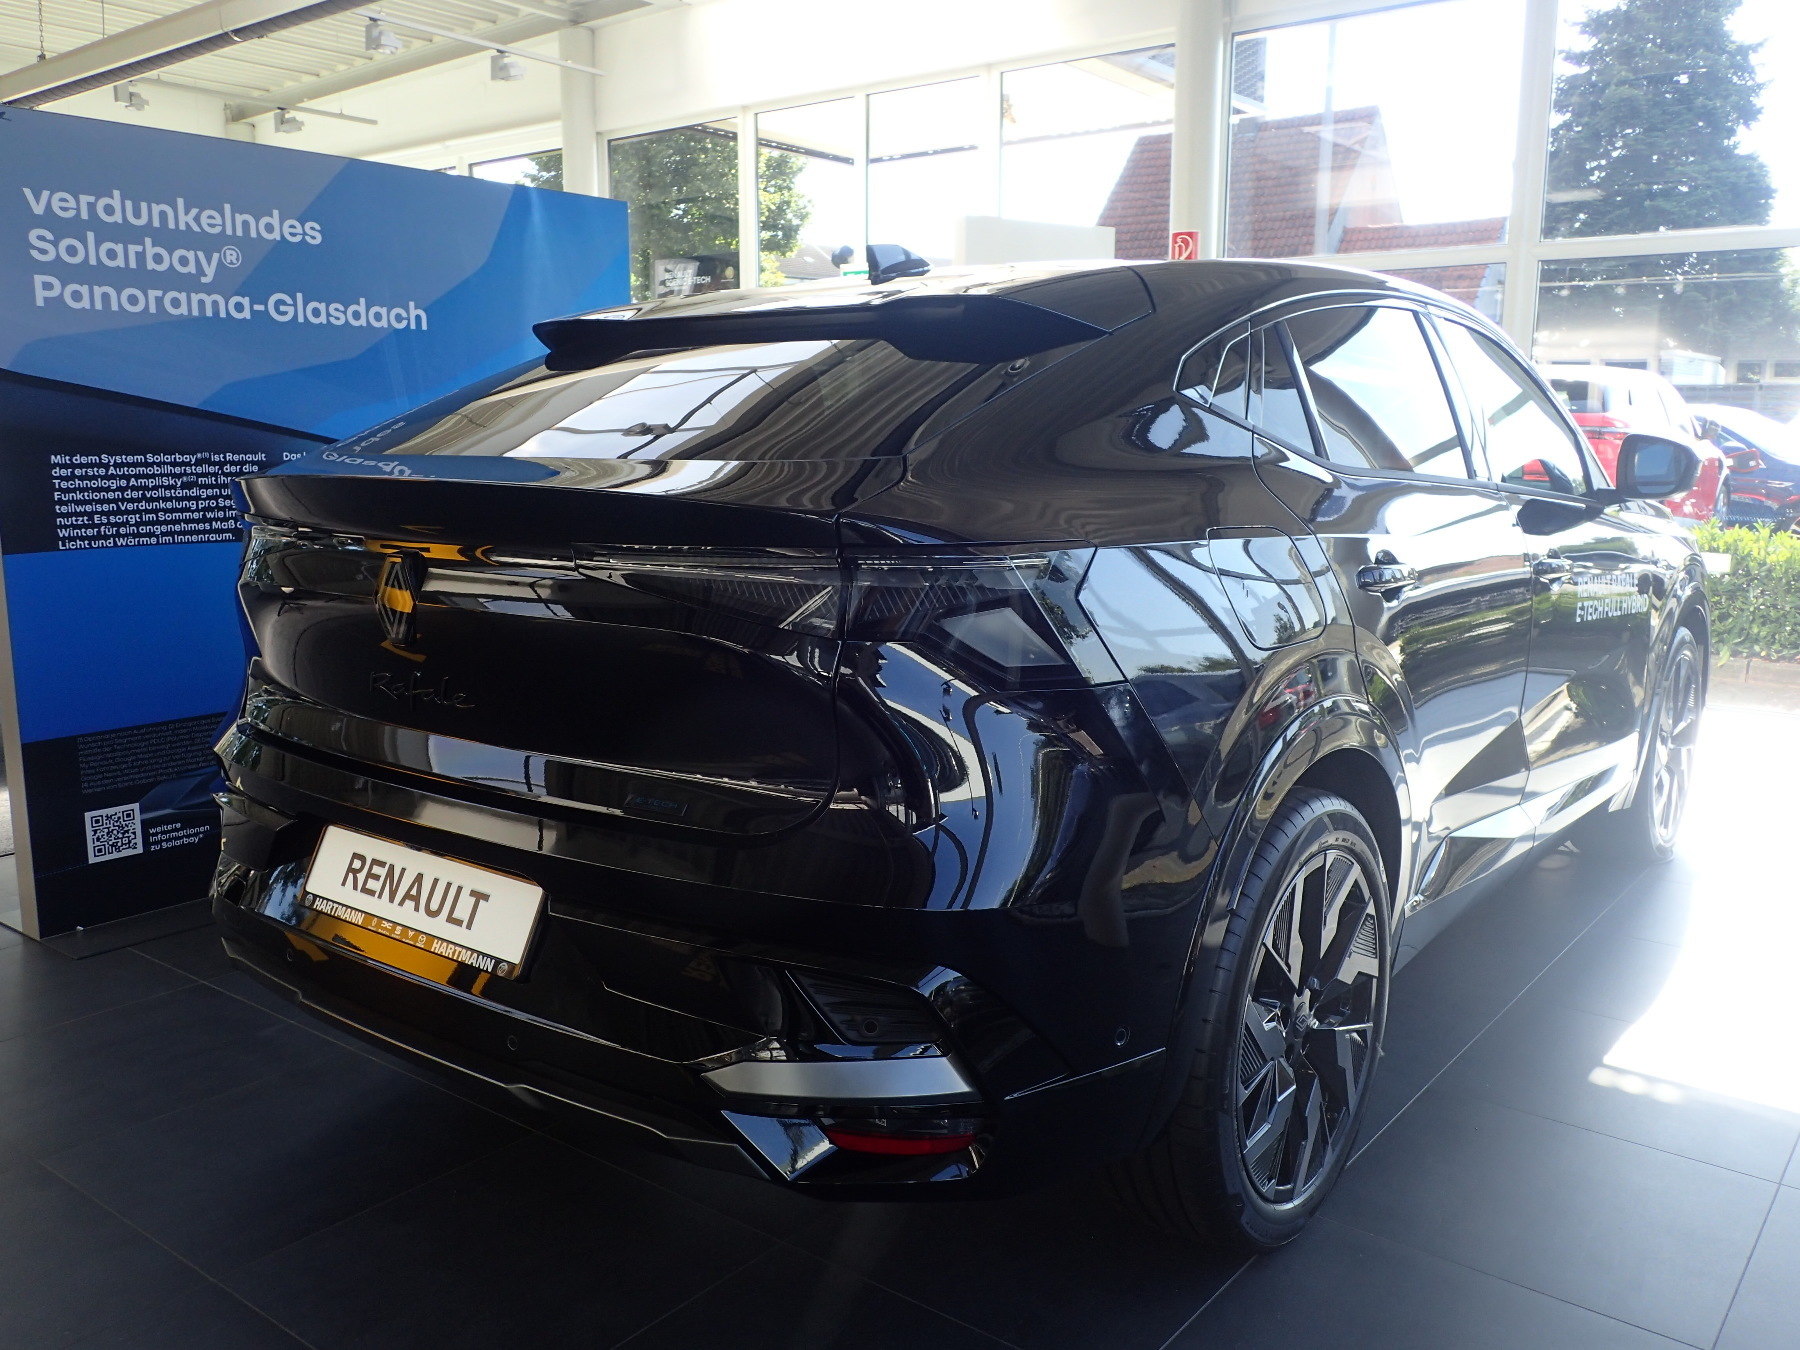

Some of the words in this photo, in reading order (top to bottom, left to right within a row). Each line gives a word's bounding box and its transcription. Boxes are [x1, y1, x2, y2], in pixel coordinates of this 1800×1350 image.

[22, 187, 322, 245] verdunkelndes
[28, 228, 242, 284] Solarbay®
[33, 274, 428, 331] Panorama-Glasdach
[50, 454, 71, 464] Mit
[72, 454, 100, 464] dem
[101, 453, 145, 465] System
[211, 452, 224, 462] ist
[226, 452, 267, 461] Renault
[51, 466, 72, 477] der
[75, 467, 106, 476] erste
[108, 464, 222, 476] Automobilhersteller,
[223, 464, 241, 473] der
[243, 463, 259, 472] die
[53, 477, 127, 489] Technologie
[198, 475, 216, 485] mit
[54, 490, 122, 501] Funktionen
[124, 489, 143, 499] der
[145, 487, 220, 498] vollständigen
[55, 503, 117, 513] teilweisen
[118, 499, 196, 511] Verdunkelung
[198, 500, 217, 511] pro
[56, 516, 92, 526] nutzt.
[94, 514, 108, 524] Es
[109, 513, 141, 524] sorgt
[142, 512, 156, 522] im
[158, 511, 204, 521] Sommer
[205, 509, 224, 519] wie
[57, 527, 99, 538] Winter
[100, 525, 117, 536] für
[119, 524, 138, 535] ein
[139, 521, 210, 535] angenehmes
[212, 520, 235, 530] Maß
[58, 539, 90, 550] Licht
[91, 538, 114, 548] und
[115, 536, 157, 547] Wärme
[159, 535, 173, 544] im
[174, 533, 235, 544] Innenraum.
[1576, 601, 1603, 623] E-TECH
[1603, 597, 1621, 618] FULL
[1621, 593, 1649, 615] HYBRID
[149, 822, 181, 834] weitere
[150, 825, 210, 843] Informationen
[340, 852, 491, 931] RENAULT
[313, 897, 366, 926] HARTMANN
[430, 939, 496, 973] HARTMANN
